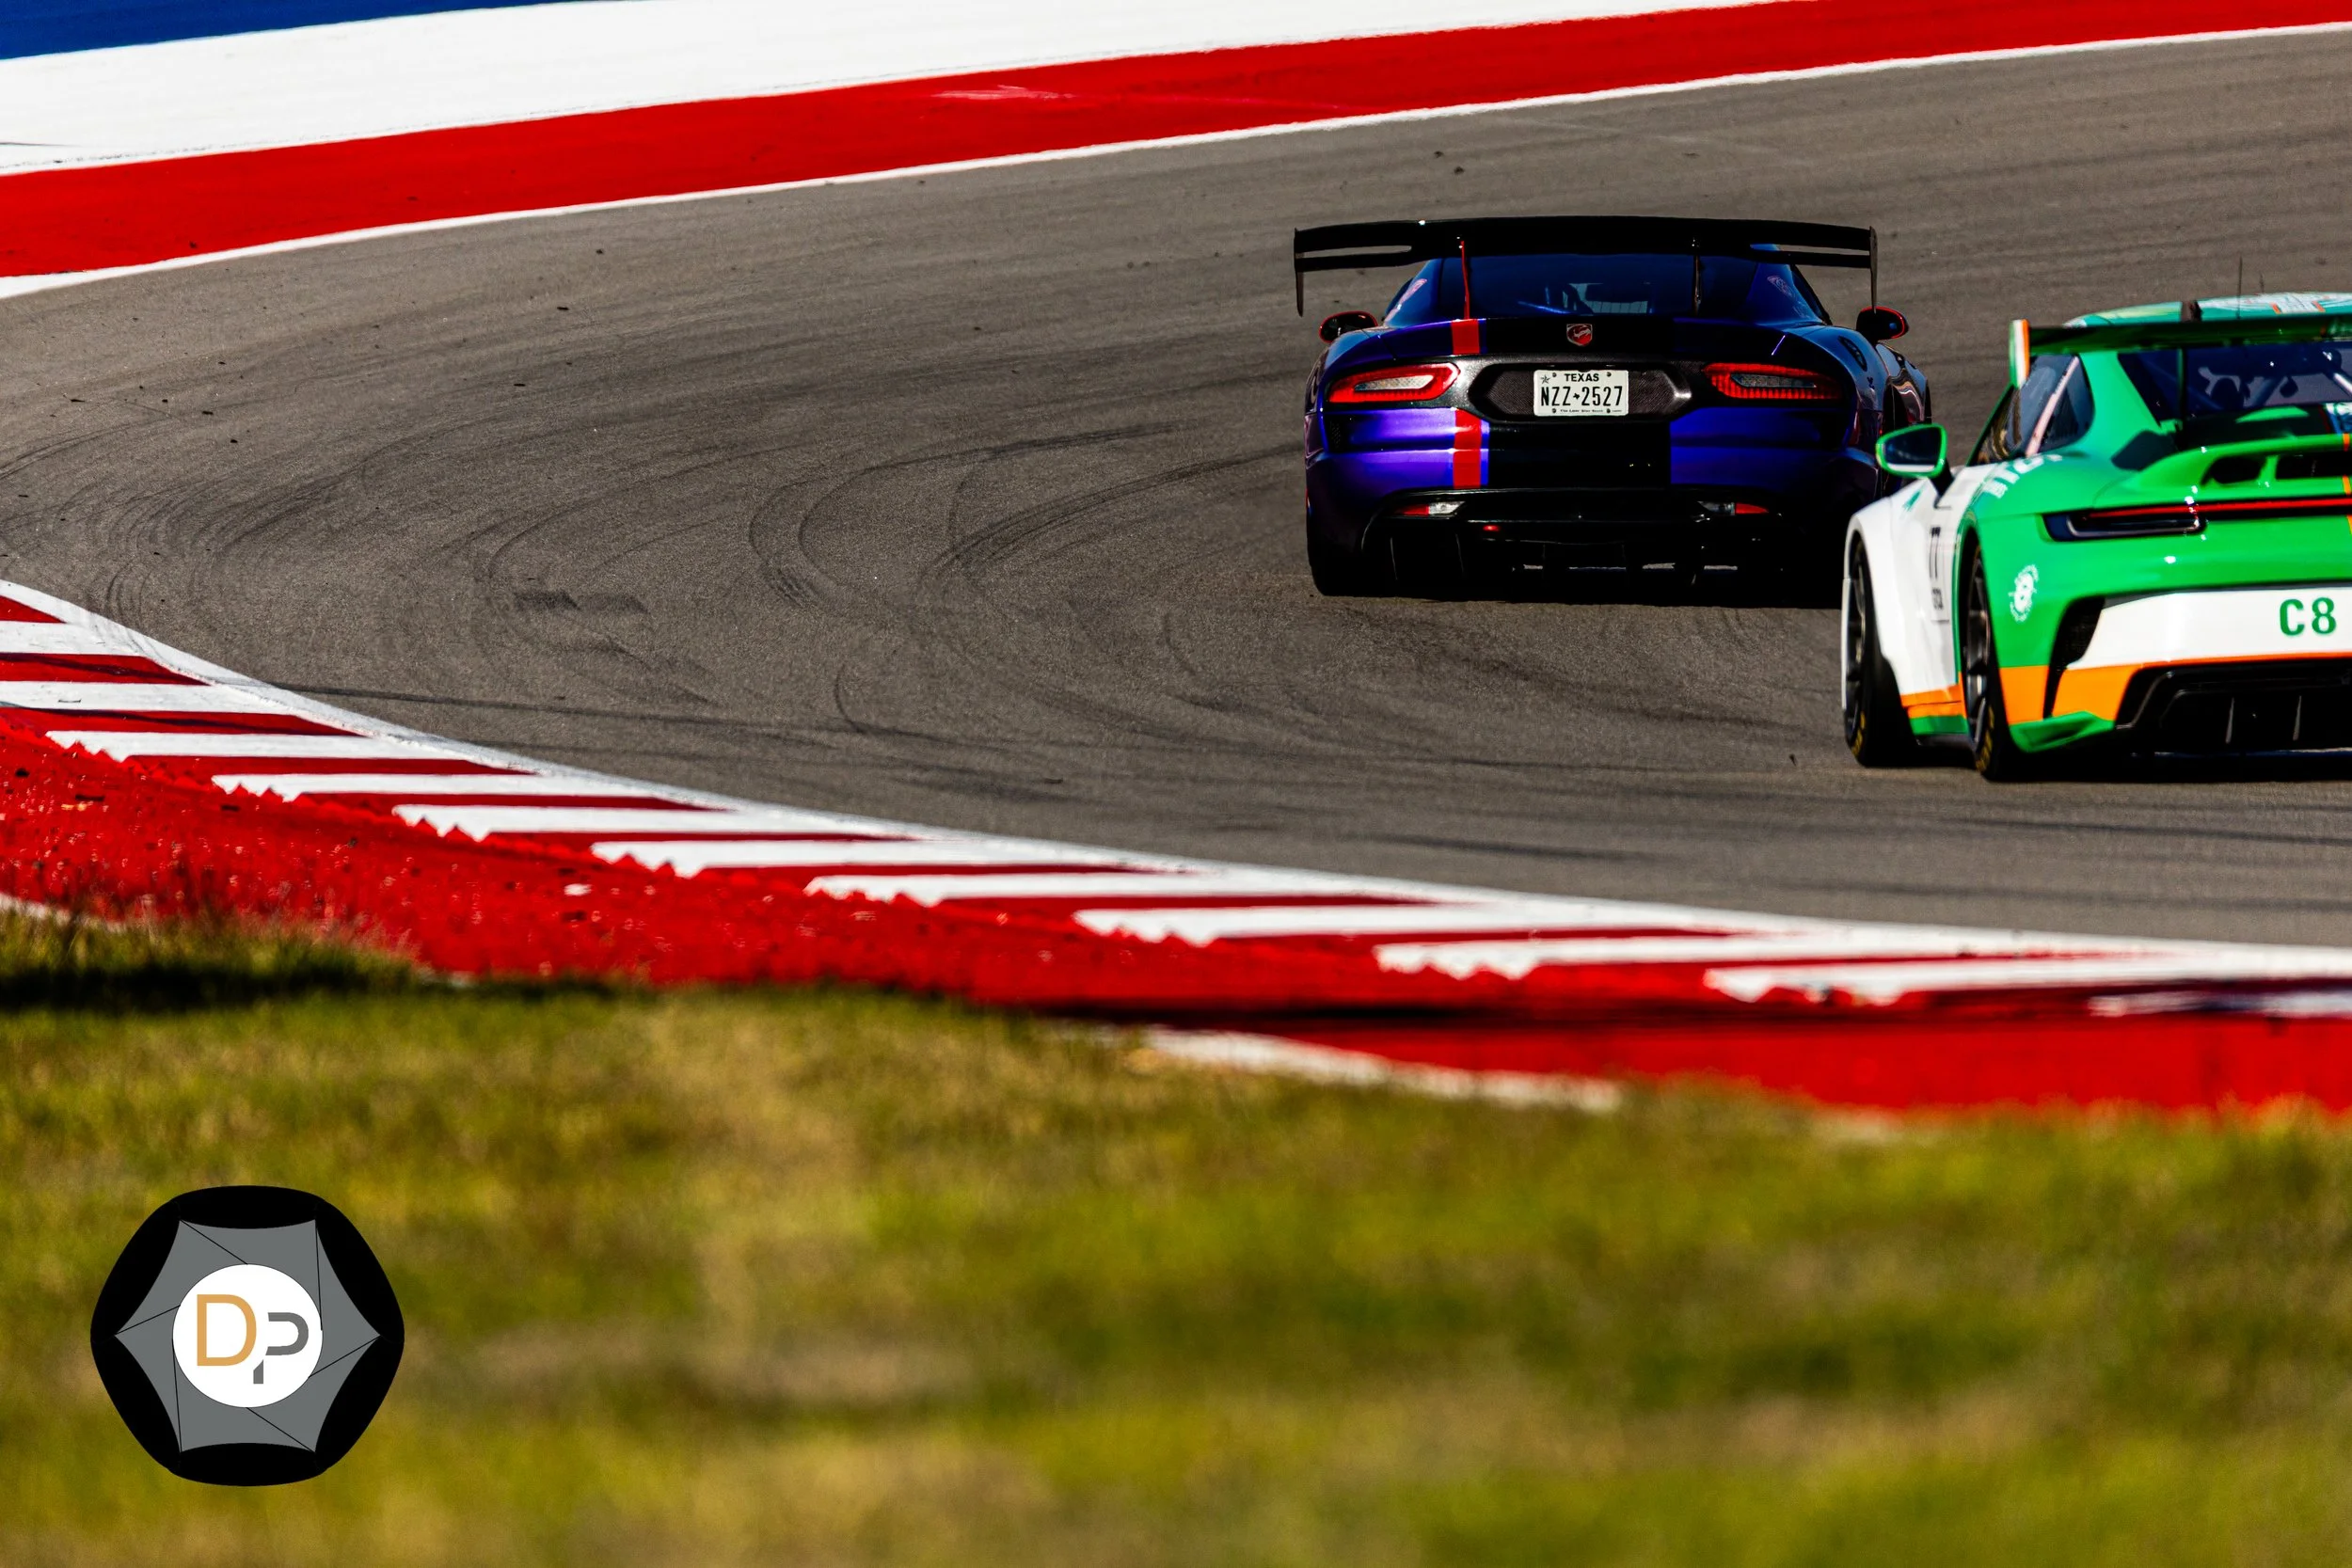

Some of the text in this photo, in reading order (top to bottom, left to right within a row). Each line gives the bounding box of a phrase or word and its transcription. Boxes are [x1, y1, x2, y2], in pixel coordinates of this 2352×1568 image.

[1564, 373, 1599, 382] TEXAS
[1540, 386, 1623, 406] NZZ 2527
[2279, 596, 2337, 636] C8
